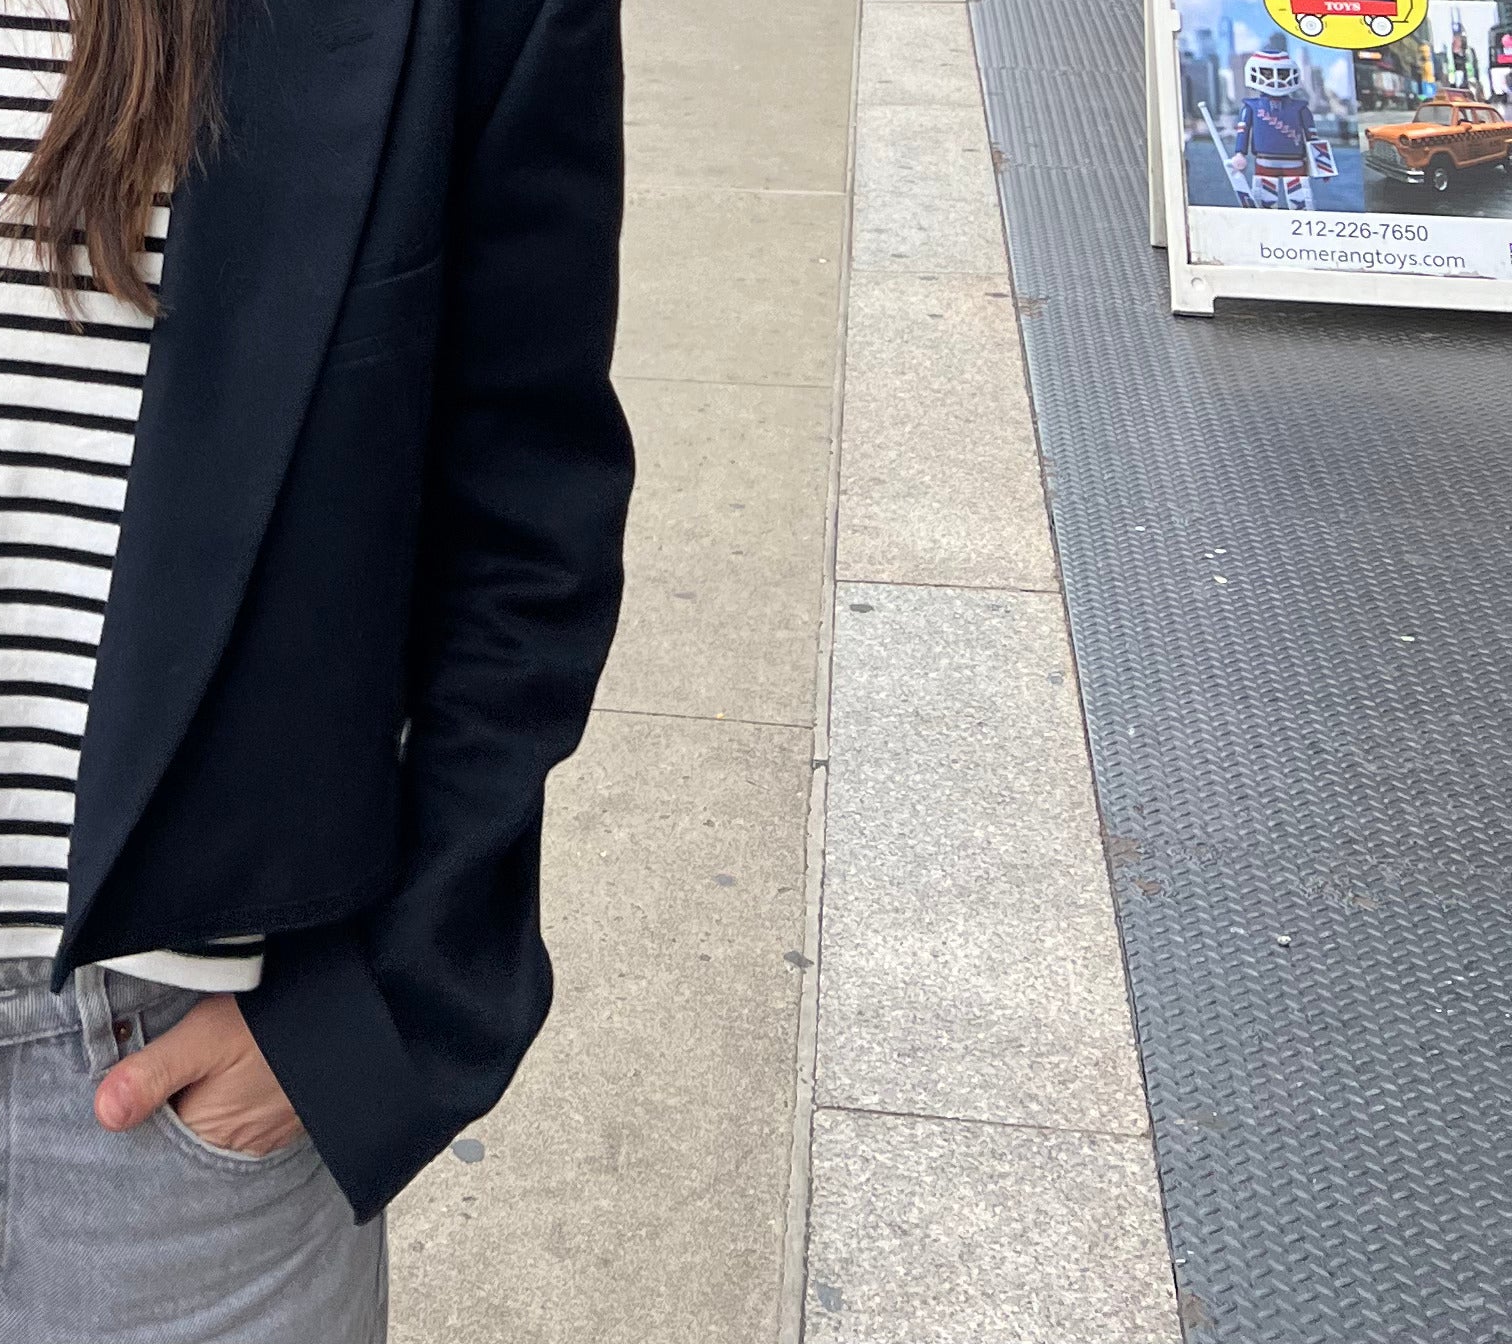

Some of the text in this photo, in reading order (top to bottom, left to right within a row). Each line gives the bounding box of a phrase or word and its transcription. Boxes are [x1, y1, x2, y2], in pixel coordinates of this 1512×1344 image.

[1323, 0, 1361, 12] TOYS
[1291, 220, 1429, 242] 212-226-7650
[1260, 243, 1466, 269] boomerangtoys.com
